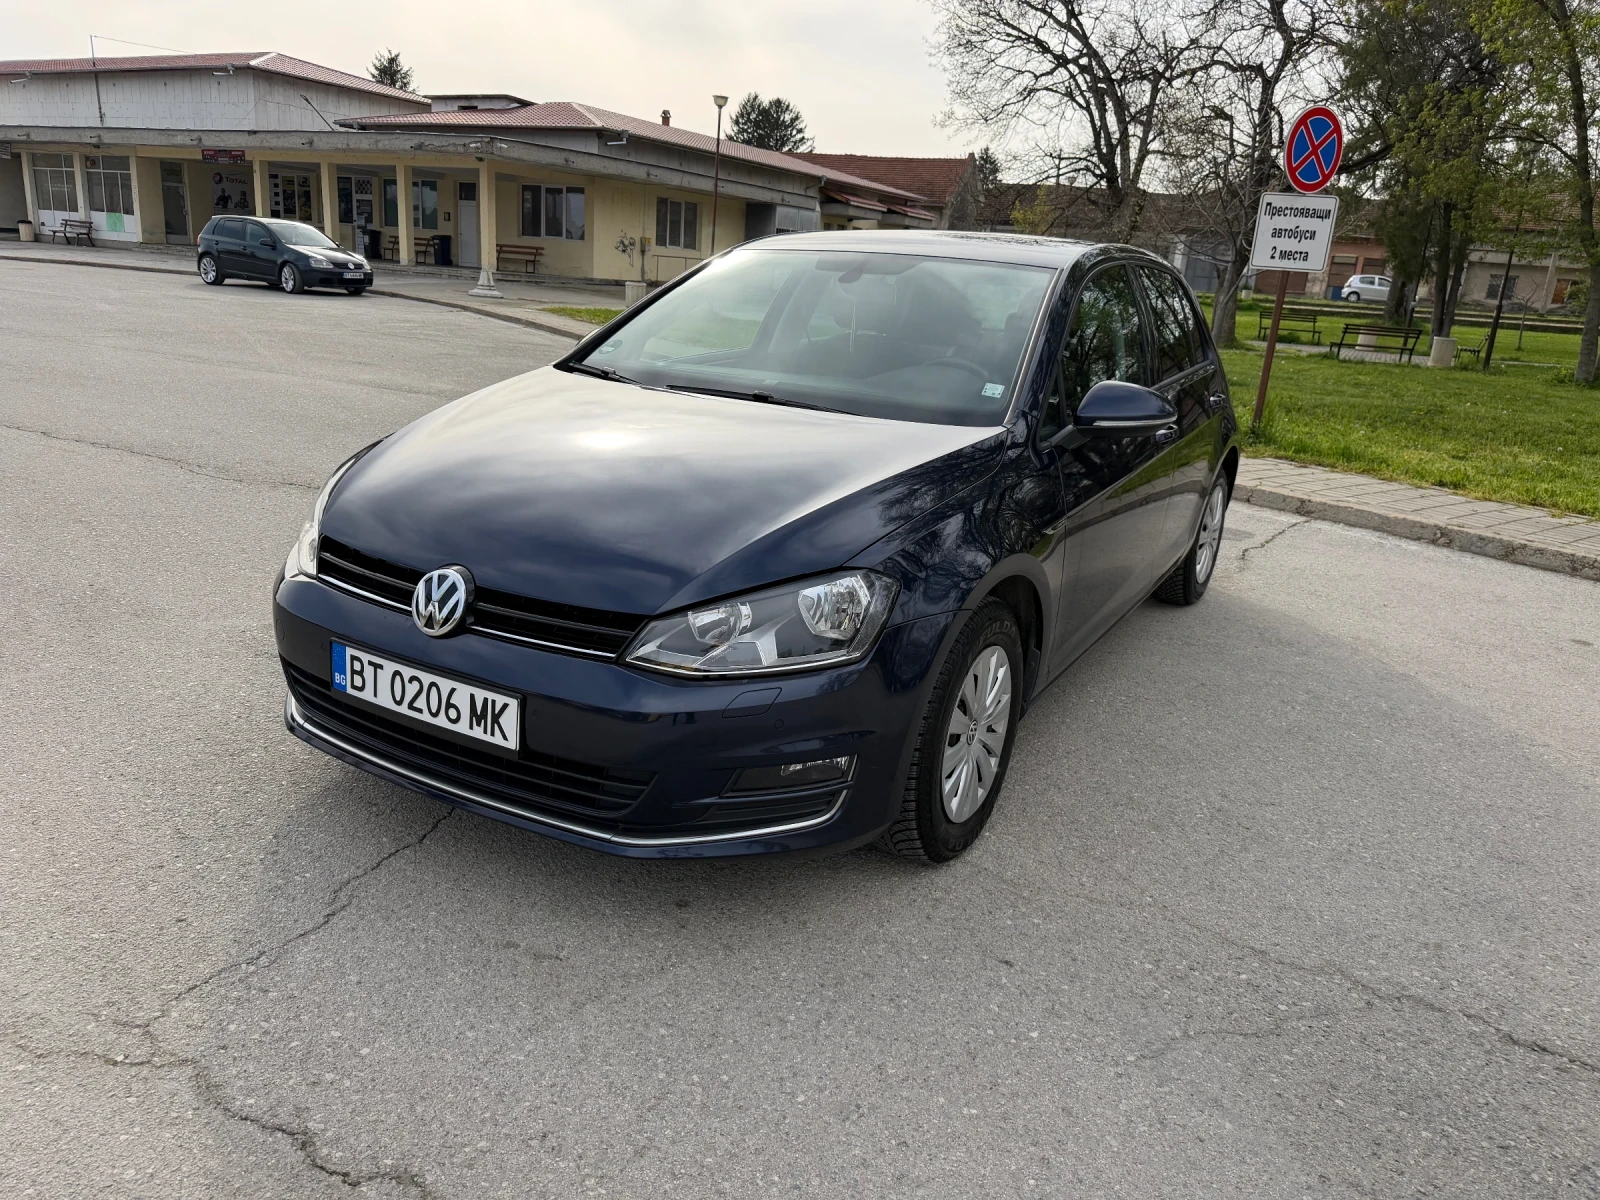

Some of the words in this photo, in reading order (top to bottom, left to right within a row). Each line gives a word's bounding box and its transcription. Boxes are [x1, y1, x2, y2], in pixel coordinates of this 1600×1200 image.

[1264, 202, 1331, 222] Престояващи
[1271, 225, 1316, 243] автобуси
[1270, 246, 1277, 260] 2
[1278, 249, 1309, 262] места
[979, 620, 1016, 645] FULDA
[335, 672, 346, 686] BG
[349, 653, 384, 698] BT
[390, 669, 461, 725] 0206
[469, 692, 510, 742] MK
